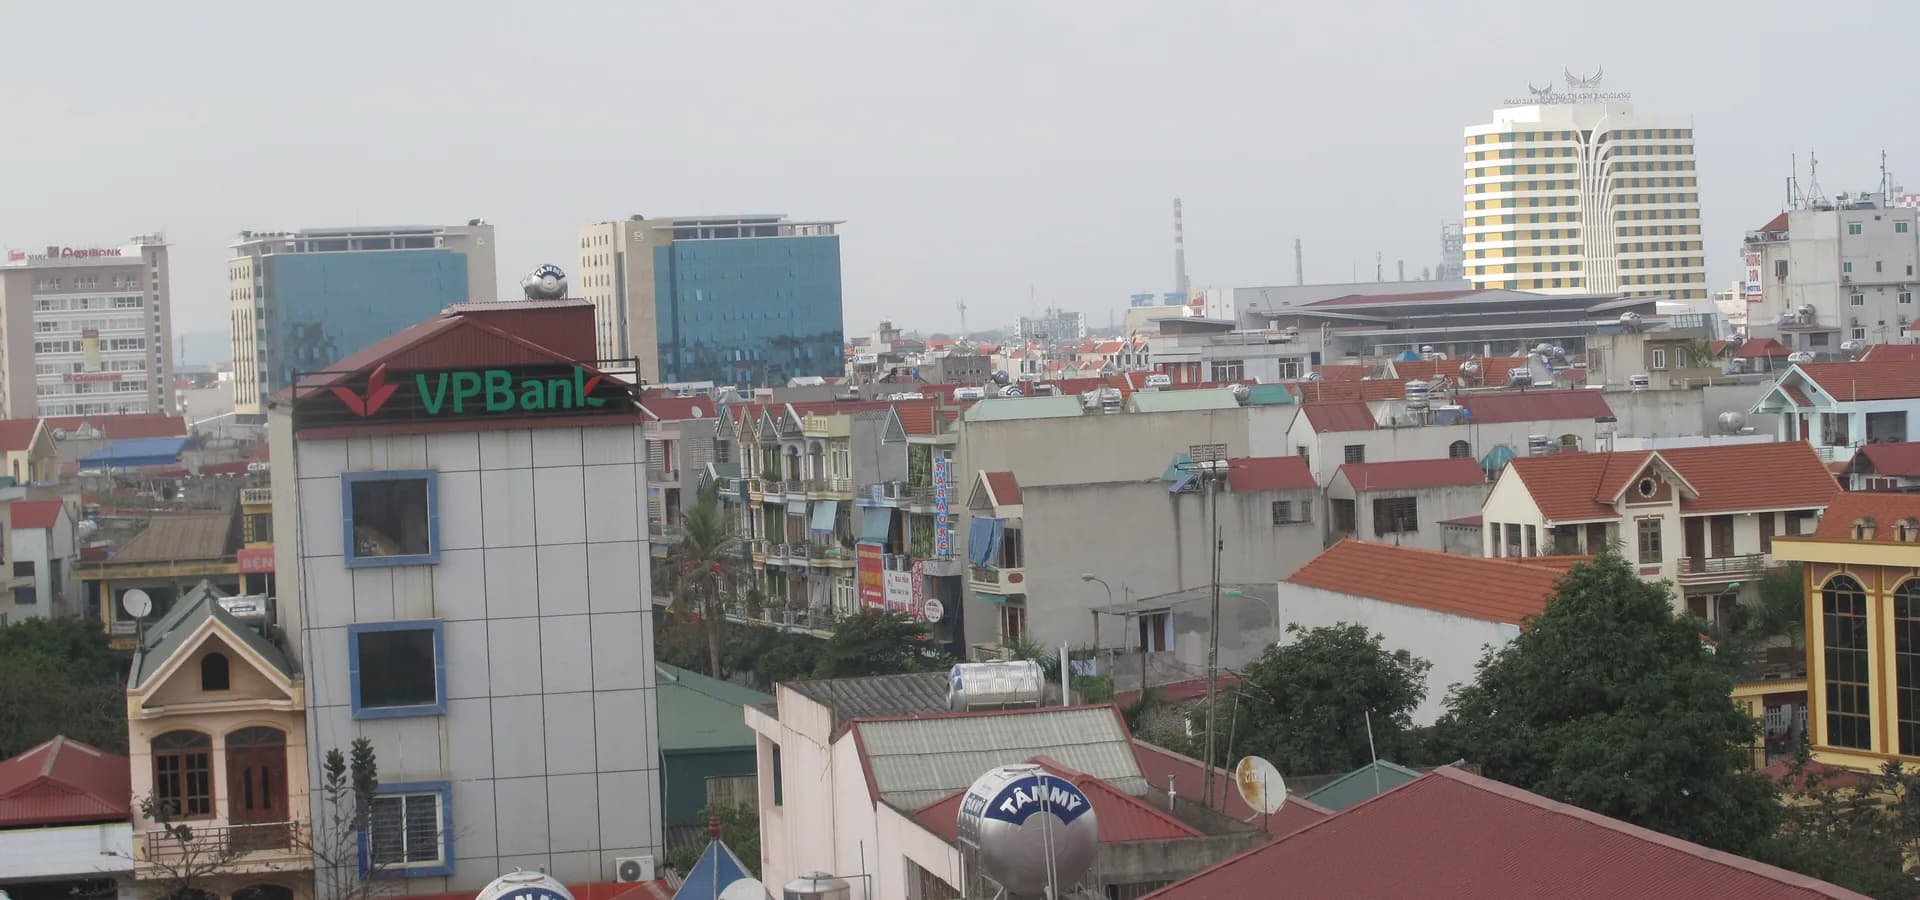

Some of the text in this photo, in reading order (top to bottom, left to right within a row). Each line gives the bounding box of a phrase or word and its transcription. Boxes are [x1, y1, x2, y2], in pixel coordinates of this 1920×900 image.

[415, 366, 606, 415] VPBank
[935, 462, 948, 550] KARAOKE
[999, 786, 1050, 815] TÂN
